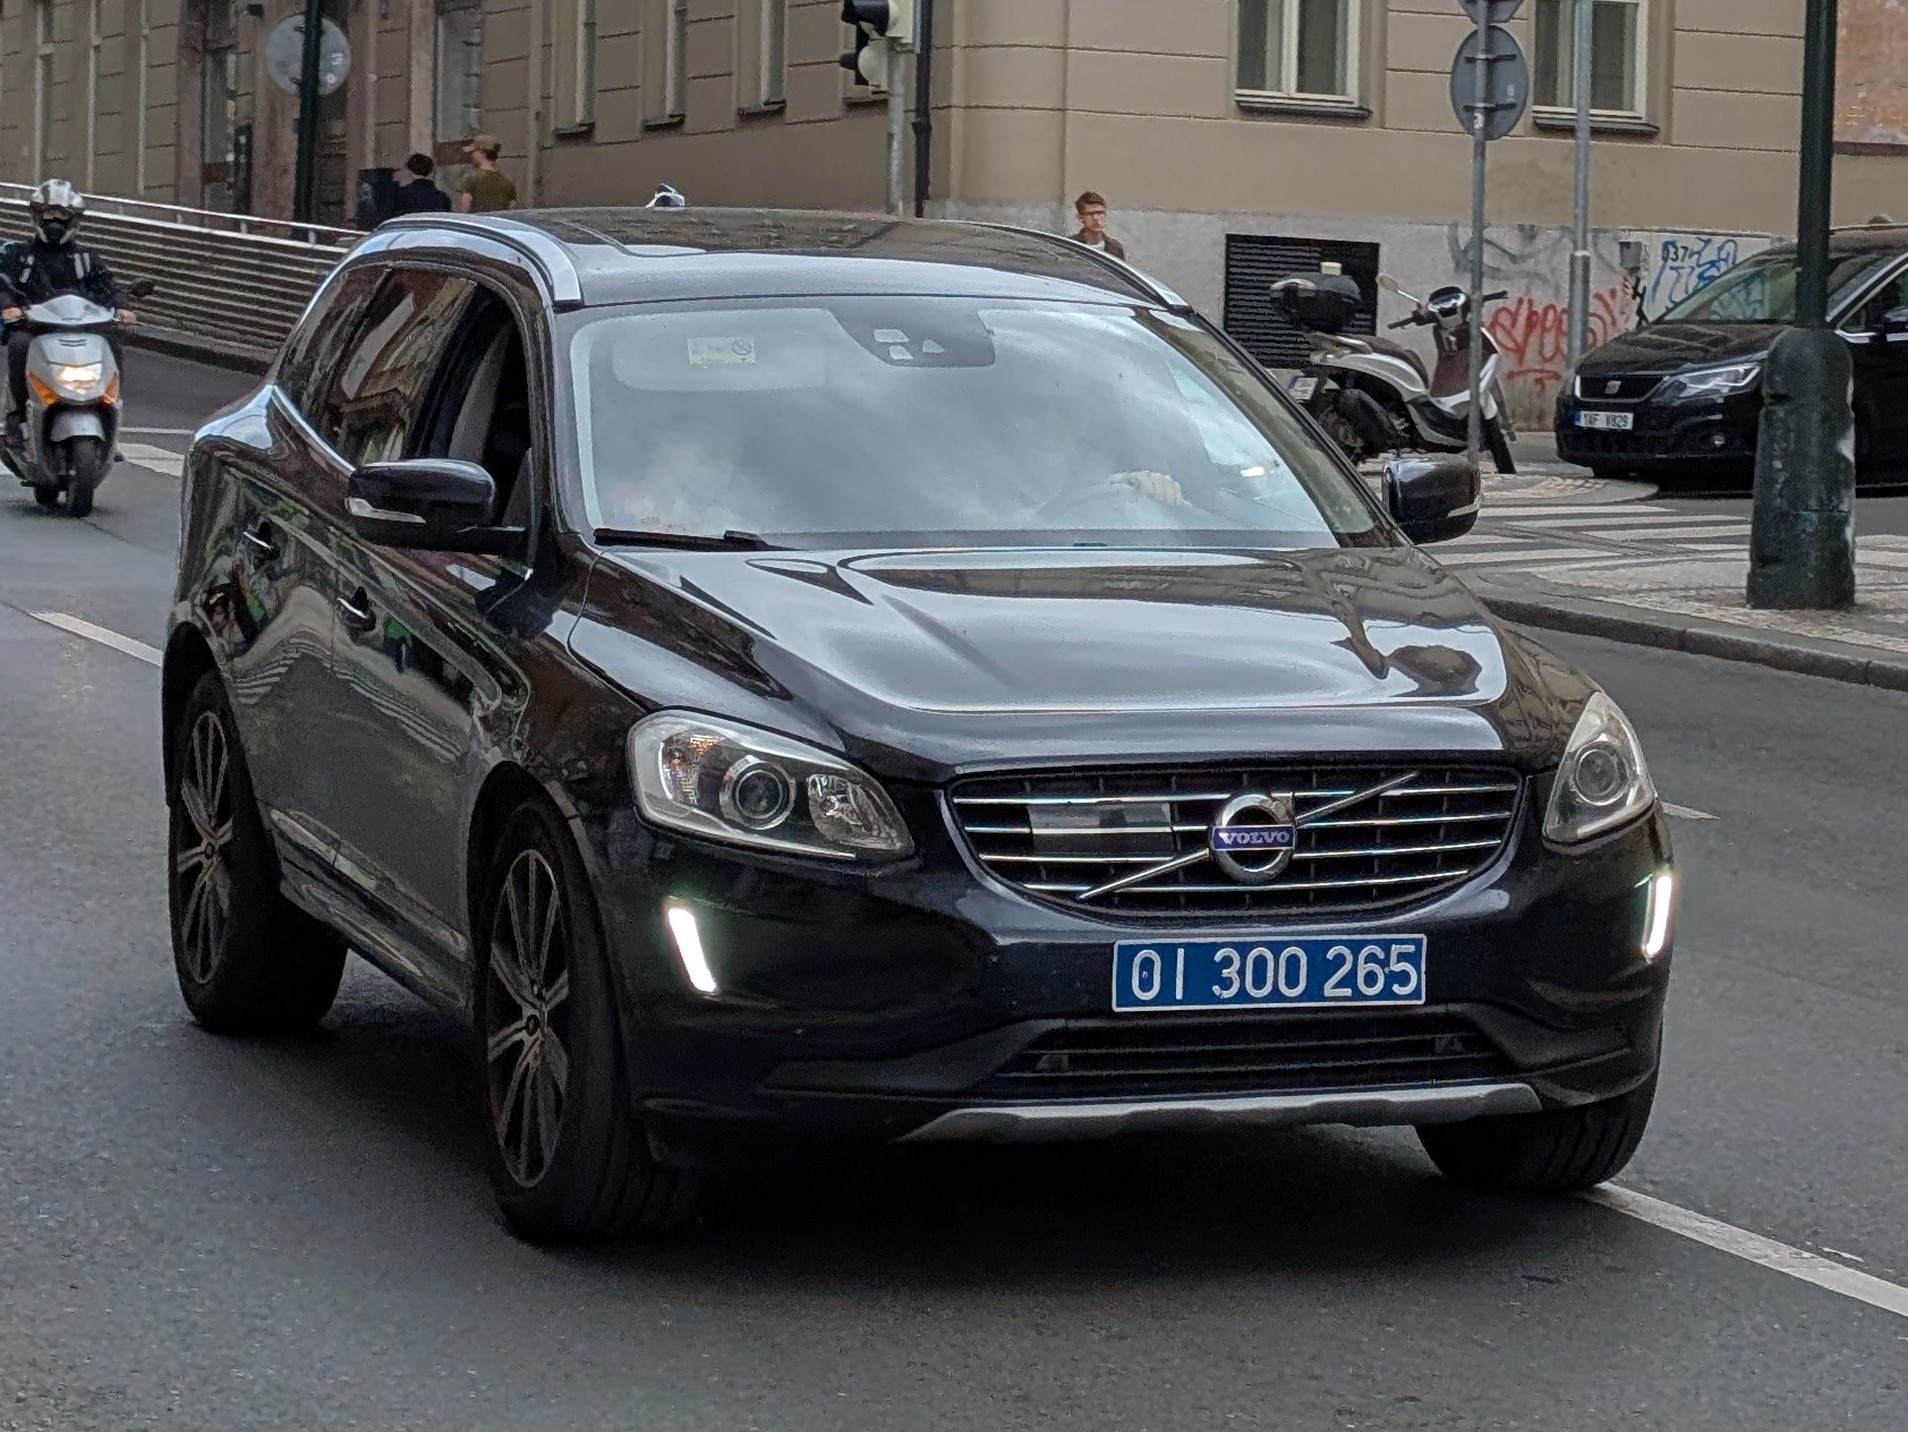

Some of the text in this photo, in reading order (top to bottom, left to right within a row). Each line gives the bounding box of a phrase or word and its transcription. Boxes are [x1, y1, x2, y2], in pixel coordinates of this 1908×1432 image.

[1218, 830, 1290, 845] VOLVO
[1212, 947, 1307, 999] 300
[1324, 945, 1418, 997] 265
